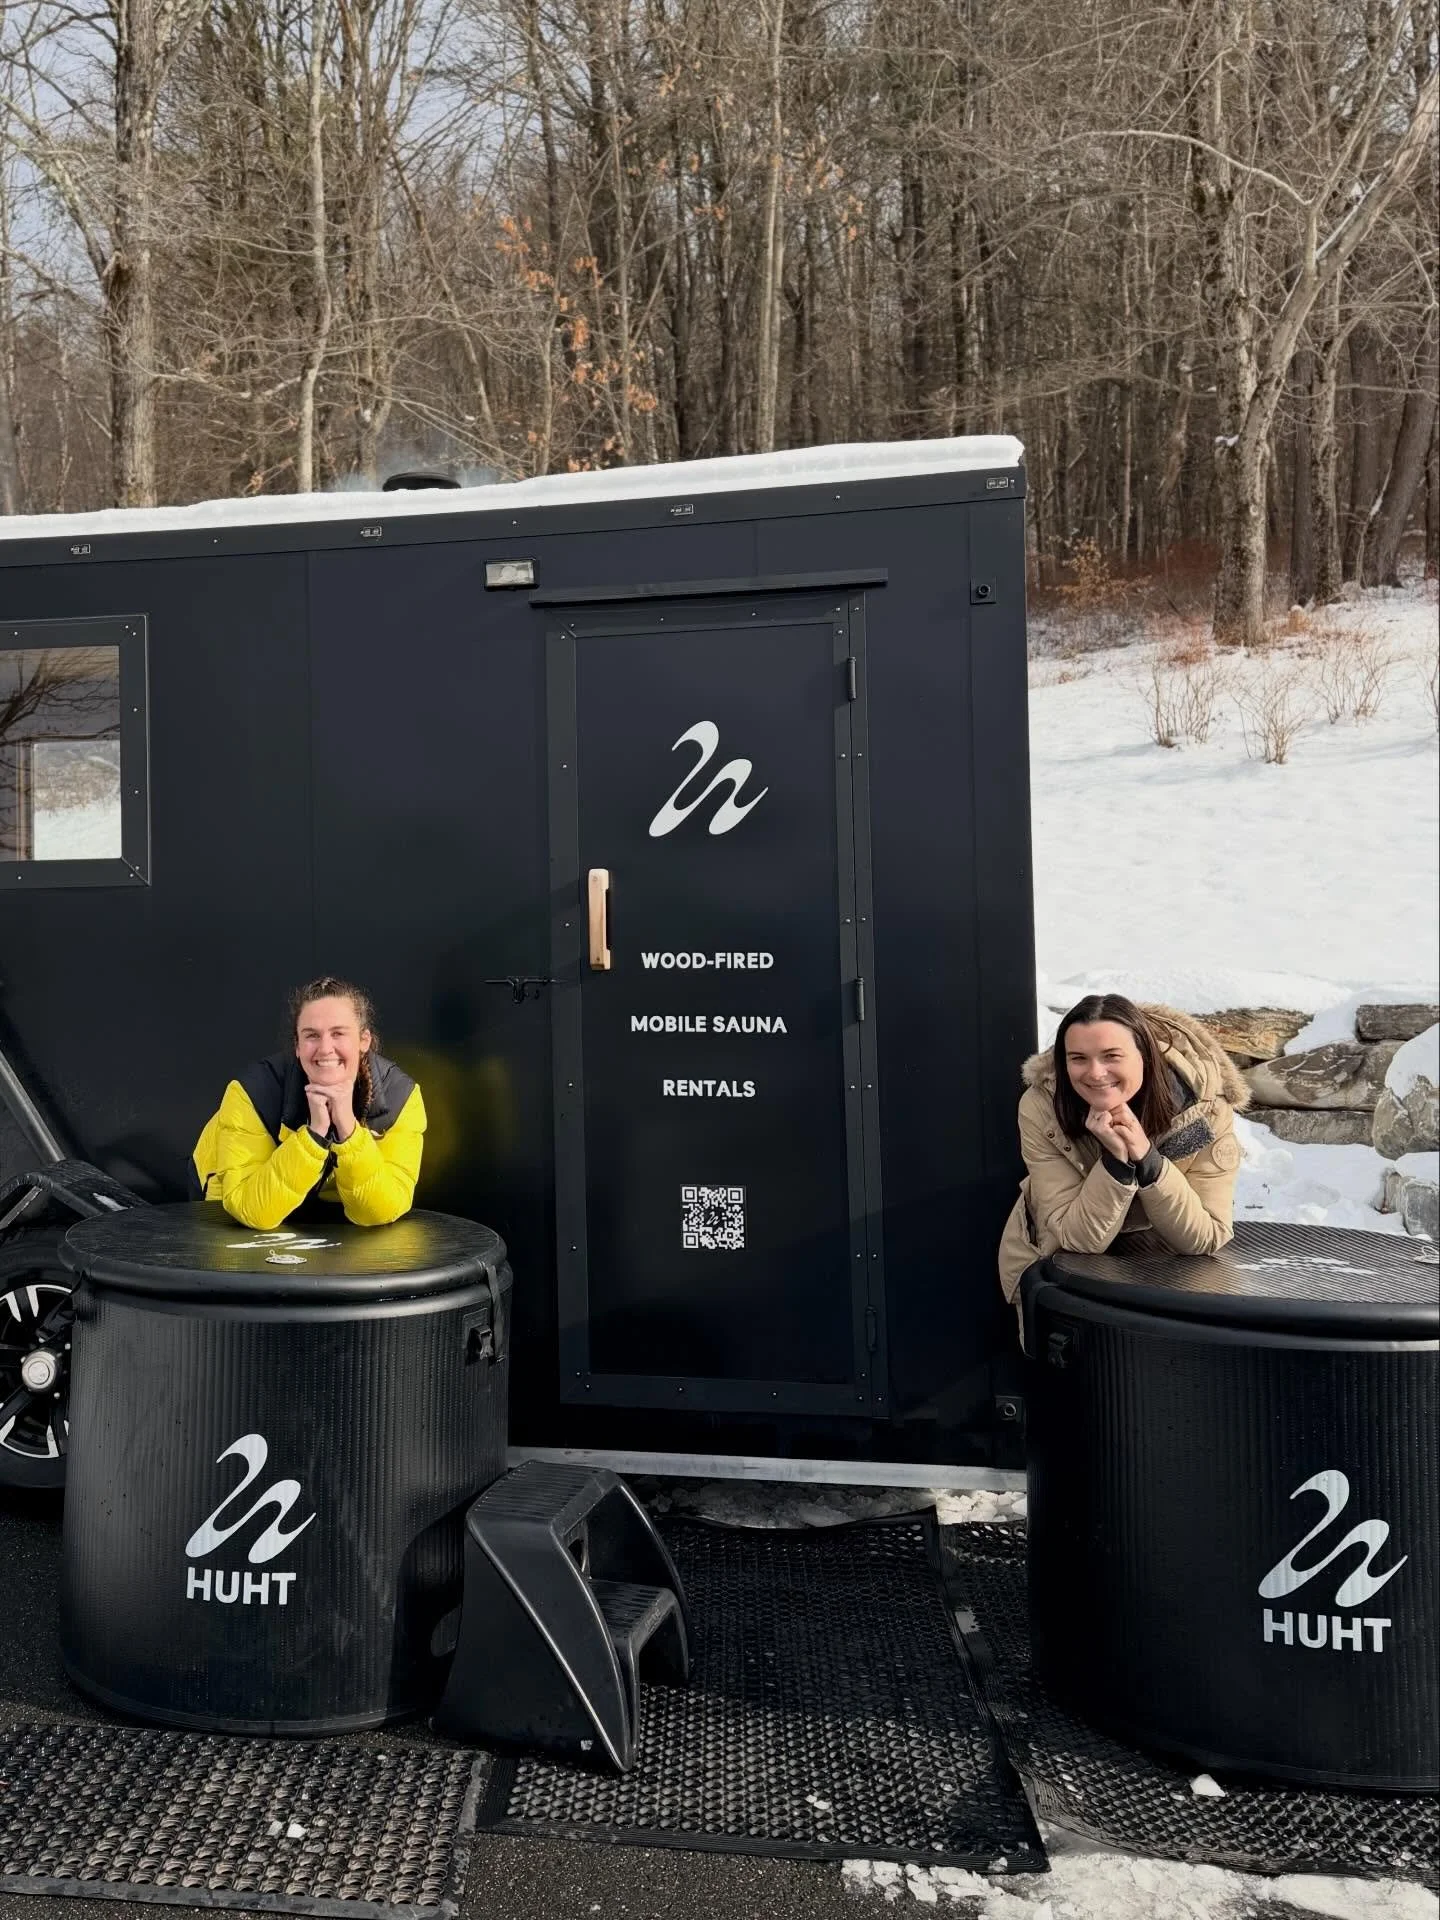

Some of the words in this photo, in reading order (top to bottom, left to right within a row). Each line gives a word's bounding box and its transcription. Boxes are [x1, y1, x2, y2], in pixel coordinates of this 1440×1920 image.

[640, 952, 774, 969] WOOD-FIRED
[630, 1015, 707, 1033] MOBILE
[712, 1015, 788, 1034] SAUNA
[662, 1079, 756, 1098] RENTALS
[186, 1566, 297, 1606] HUHT
[1263, 1608, 1392, 1653] HUHT
